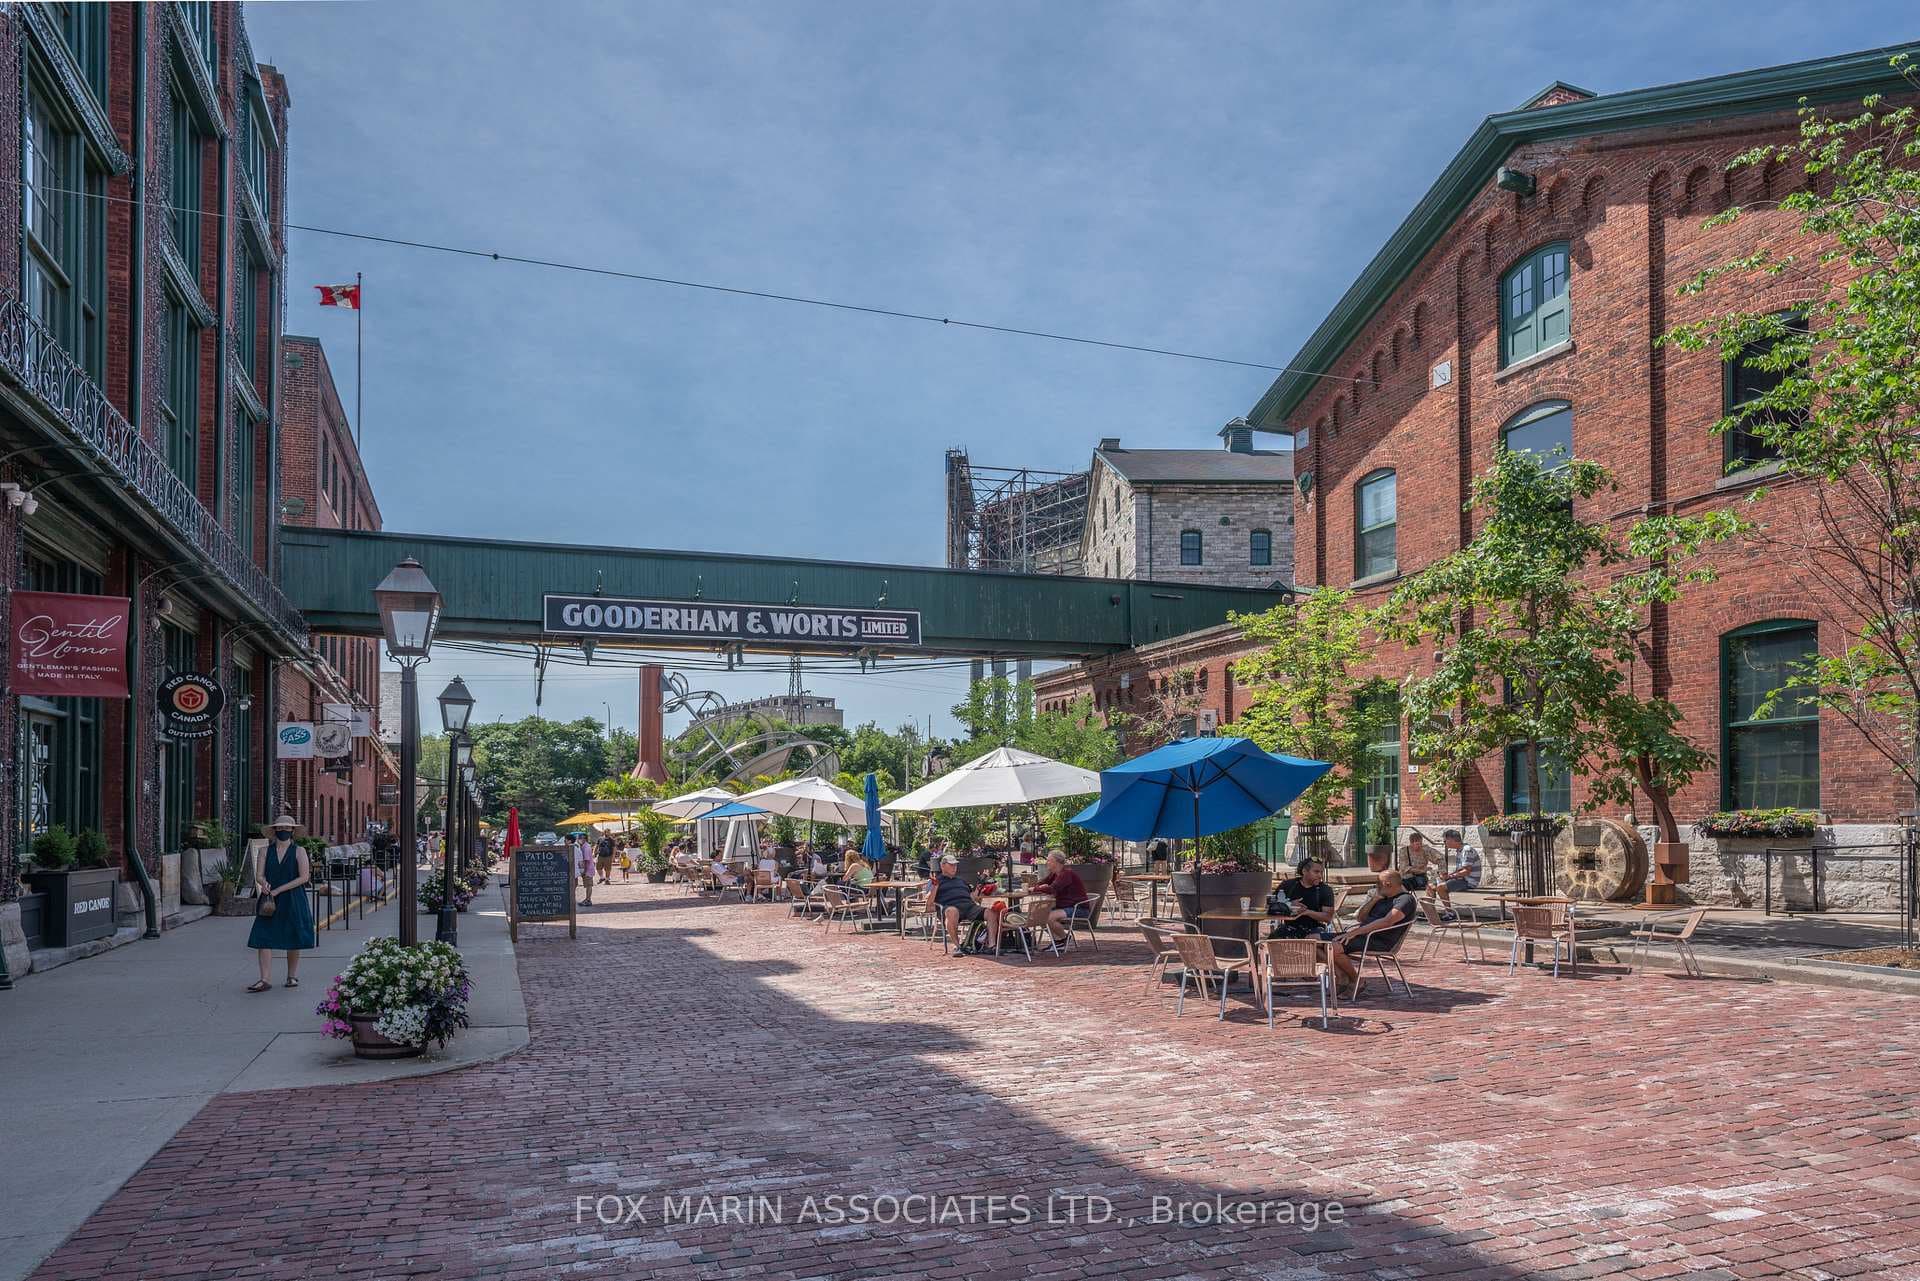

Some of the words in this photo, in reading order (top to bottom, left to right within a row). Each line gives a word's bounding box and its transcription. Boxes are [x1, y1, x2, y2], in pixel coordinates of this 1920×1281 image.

[562, 603, 739, 633] GOODERHAM
[746, 611, 768, 634] &
[769, 612, 858, 637] WORTS
[861, 620, 908, 635] LIMITED
[19, 615, 122, 644] Gentil
[30, 632, 117, 659] Uomo
[17, 663, 79, 672] GENTLEMAN'S
[81, 665, 120, 673] FASHION.
[165, 676, 184, 690] RED
[185, 674, 217, 692] CANOE
[171, 711, 210, 723] CANADA
[168, 729, 214, 738] OUTFITTER
[525, 851, 554, 861] PATIO
[74, 901, 88, 914] RED
[88, 898, 110, 911] CANOE
